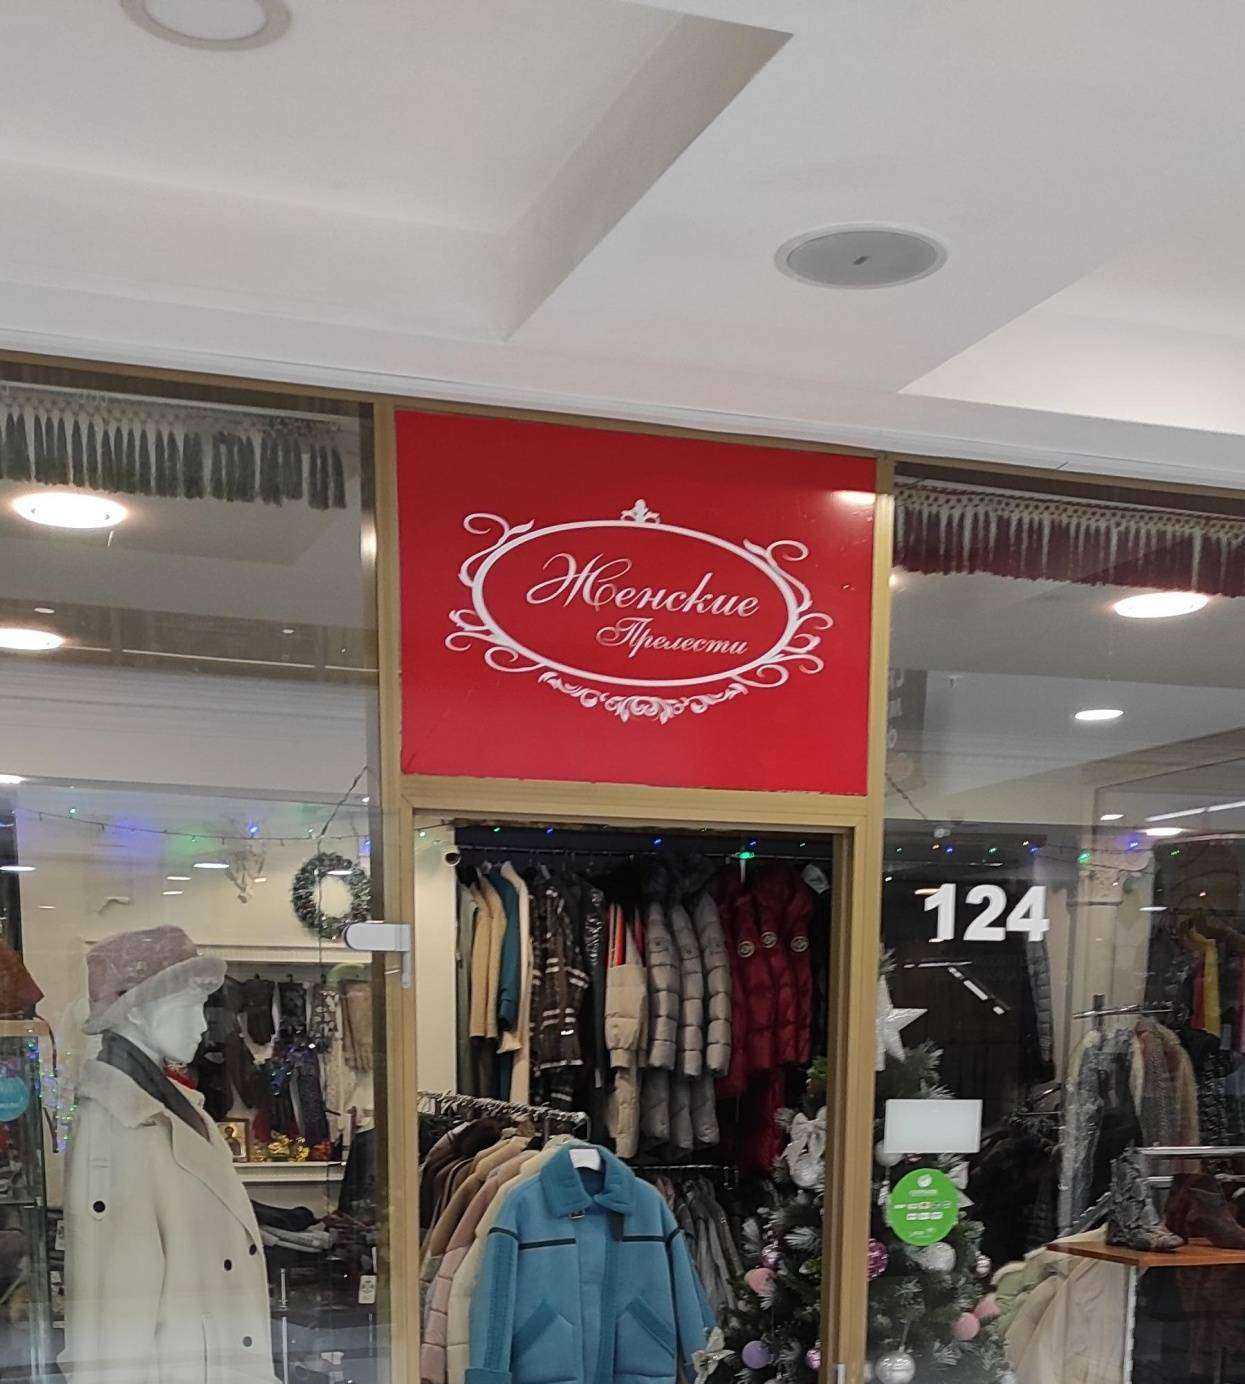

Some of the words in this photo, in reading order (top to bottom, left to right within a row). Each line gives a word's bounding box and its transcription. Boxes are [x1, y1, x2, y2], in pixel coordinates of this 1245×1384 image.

[526, 552, 760, 617] Женские
[596, 617, 749, 658] Прелести
[923, 883, 1050, 943] 124
